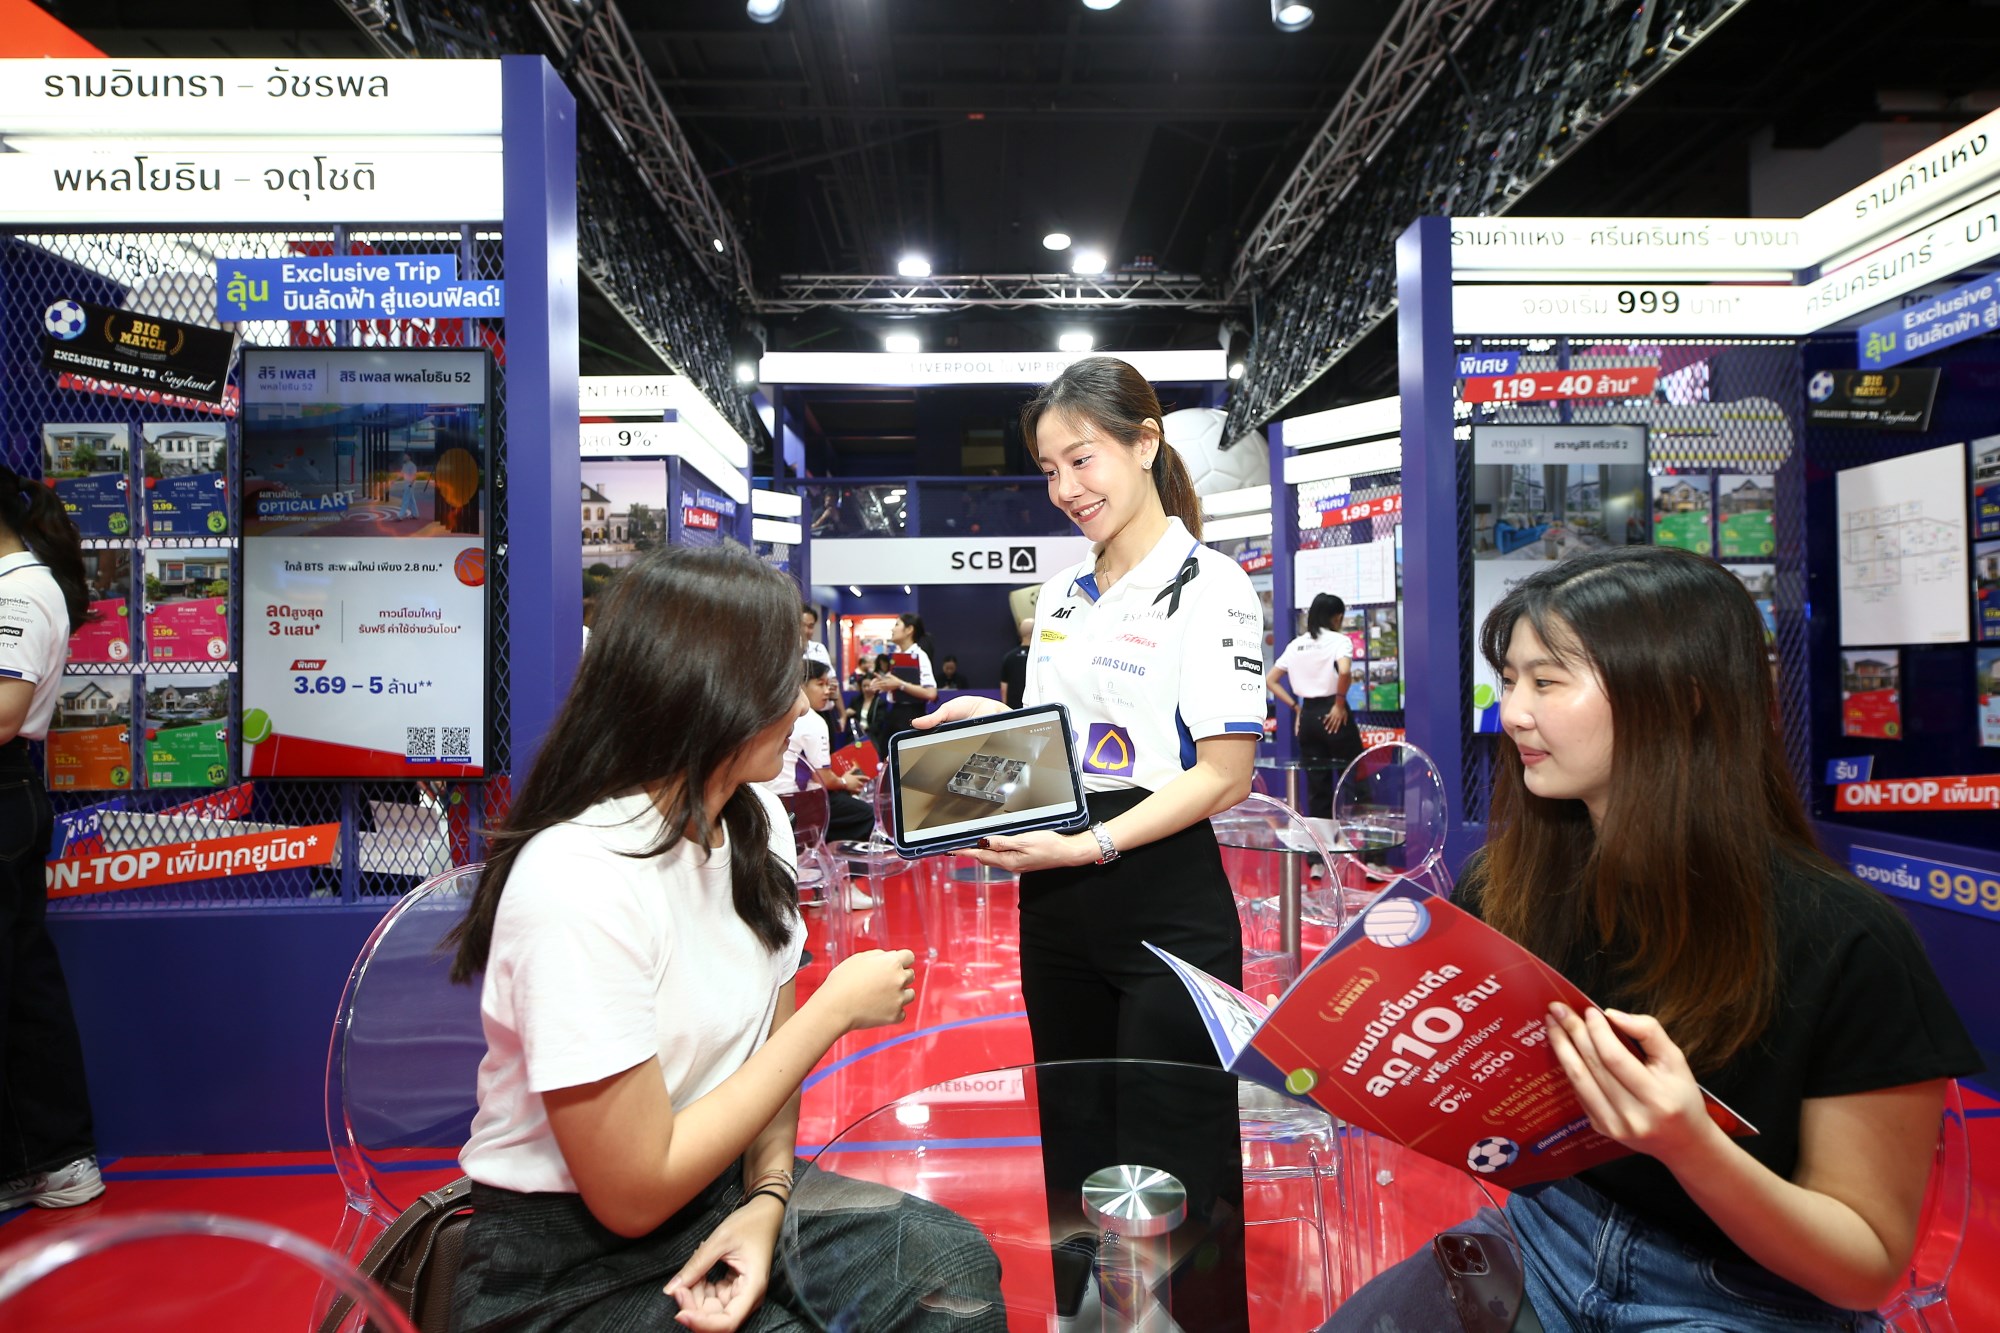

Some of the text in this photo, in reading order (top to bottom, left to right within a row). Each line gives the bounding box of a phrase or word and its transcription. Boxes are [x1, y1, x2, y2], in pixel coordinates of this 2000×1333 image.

[44, 69, 225, 97] รามอินทรา
[267, 66, 389, 97] วัชรพล
[54, 155, 220, 191] พหลโยธิน
[263, 155, 375, 201] จตุโชติ
[1856, 133, 1988, 218] รามคำแหง
[1451, 225, 1799, 246] รามคำแหง ศรีนครินทร์ บางนา
[282, 261, 441, 285] Exclusive Trip
[1806, 233, 1935, 315] ศรีนครินทร์
[226, 271, 269, 312] ลุ้น
[283, 285, 500, 315] บินลัดฟ้า สู่แอนฟิลด์!
[1617, 290, 1680, 314] 999
[1904, 285, 1992, 330] Exclusive
[132, 320, 160, 337] BIG
[119, 331, 167, 352] MATCH
[1865, 331, 1897, 361] ลุ้น
[53, 350, 110, 370] EXCLUSIVE
[112, 361, 139, 376] TRIP
[141, 367, 157, 379] TO
[160, 370, 216, 392] England
[911, 361, 994, 372] LIVERPOOL
[1018, 362, 1041, 372] VIP
[1460, 357, 1509, 375] พิเศษ
[339, 370, 471, 384] สิริ เพลส พหลโยธิน 52
[1862, 375, 1883, 386] BIG
[616, 385, 670, 397] HOME
[1492, 377, 1536, 400] 1.19
[1557, 375, 1593, 396] 40
[1855, 387, 1888, 397] MATCH
[1880, 410, 1923, 425] England
[152, 503, 173, 511] 9.99
[259, 490, 356, 513] OPTICAL ART
[1341, 503, 1371, 521] 1.99
[1383, 498, 1394, 512] 9
[213, 518, 221, 528] 3
[284, 560, 302, 571] ใกล้
[304, 563, 324, 571] BTS
[378, 561, 402, 572] เพียง
[404, 562, 420, 571] 2.8
[951, 551, 1003, 569] SCB
[379, 607, 442, 620] ทาวน์โฮมใหญ่
[1051, 606, 1076, 619] Ari
[153, 628, 173, 637] 3.99
[268, 621, 281, 636] 3
[213, 643, 221, 654] 3
[1092, 656, 1145, 676] SAMSUNG
[1238, 659, 1260, 671] Lenovo
[293, 675, 347, 695] 3.69
[369, 676, 383, 695] 5
[1836, 761, 1858, 780] รับ
[1845, 782, 1939, 805] ON-TOP
[1856, 864, 2000, 912] จองเริ่ม 999
[1333, 977, 1374, 1016] ARENA
[1365, 1057, 1414, 1098] ลด
[1392, 1006, 1464, 1060] 10
[1501, 1071, 1551, 1112] EXCLUSIVE
